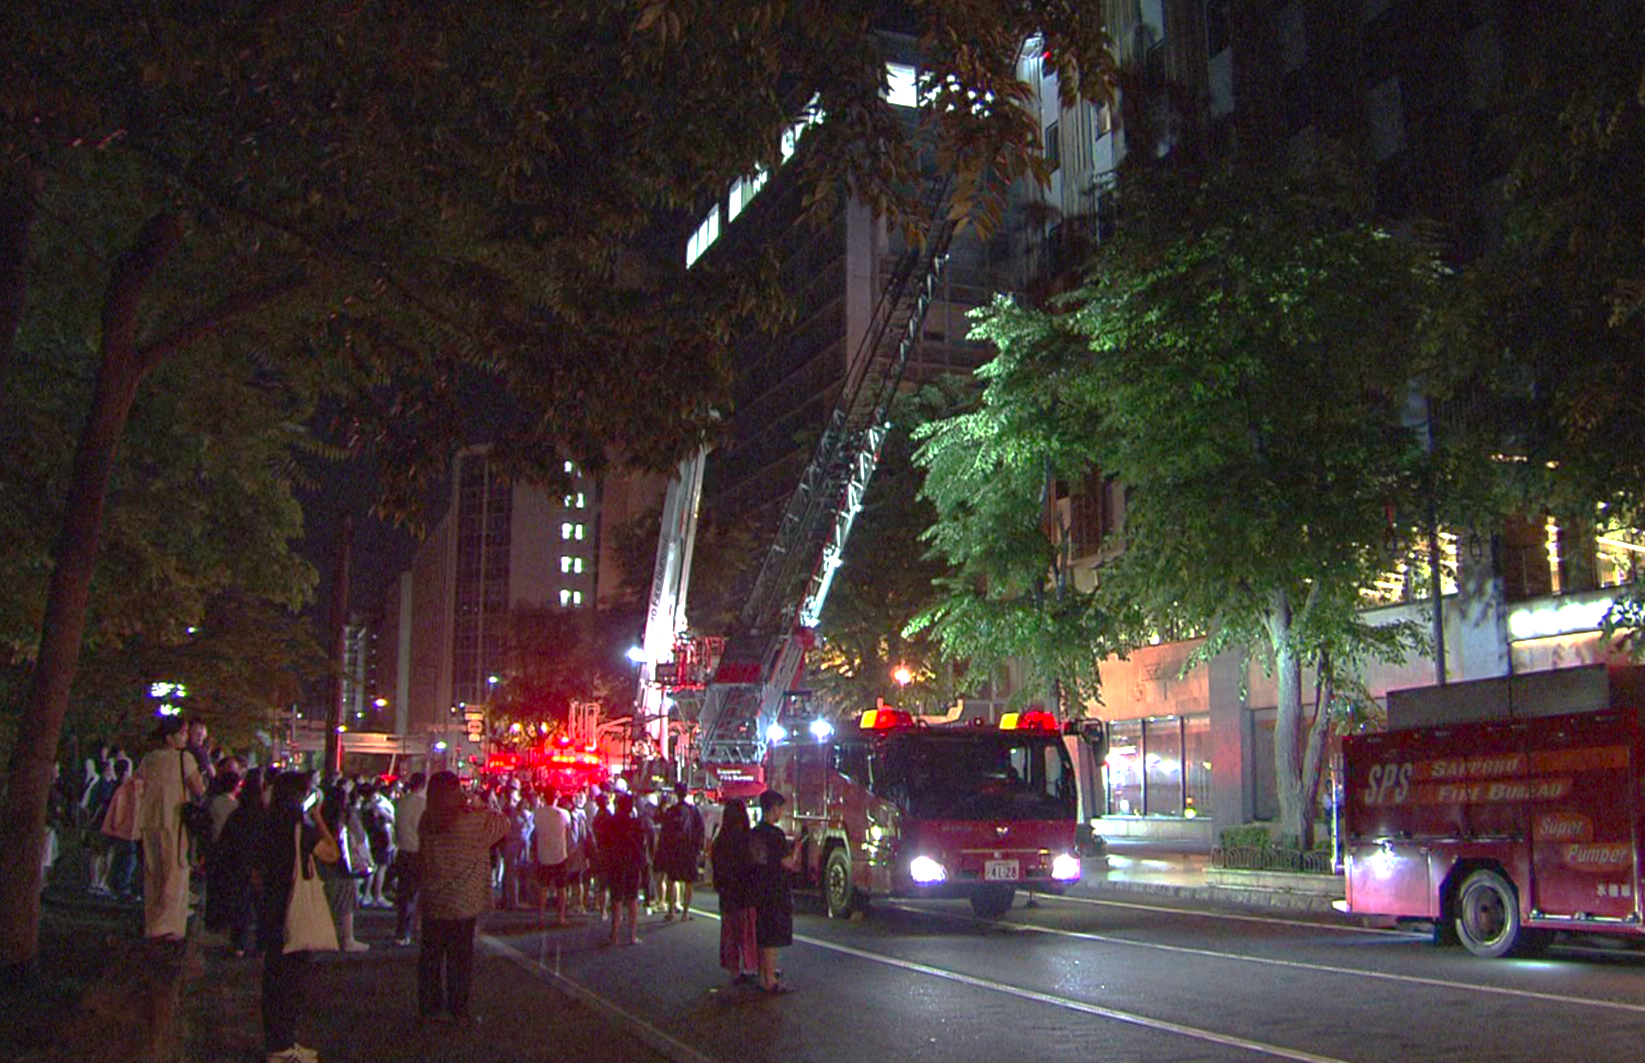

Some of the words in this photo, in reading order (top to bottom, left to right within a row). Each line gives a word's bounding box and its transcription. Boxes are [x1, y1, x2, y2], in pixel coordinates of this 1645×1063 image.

[1365, 763, 1412, 804] SPS
[1540, 816, 1584, 837] Super
[1568, 844, 1629, 863] Pumper
